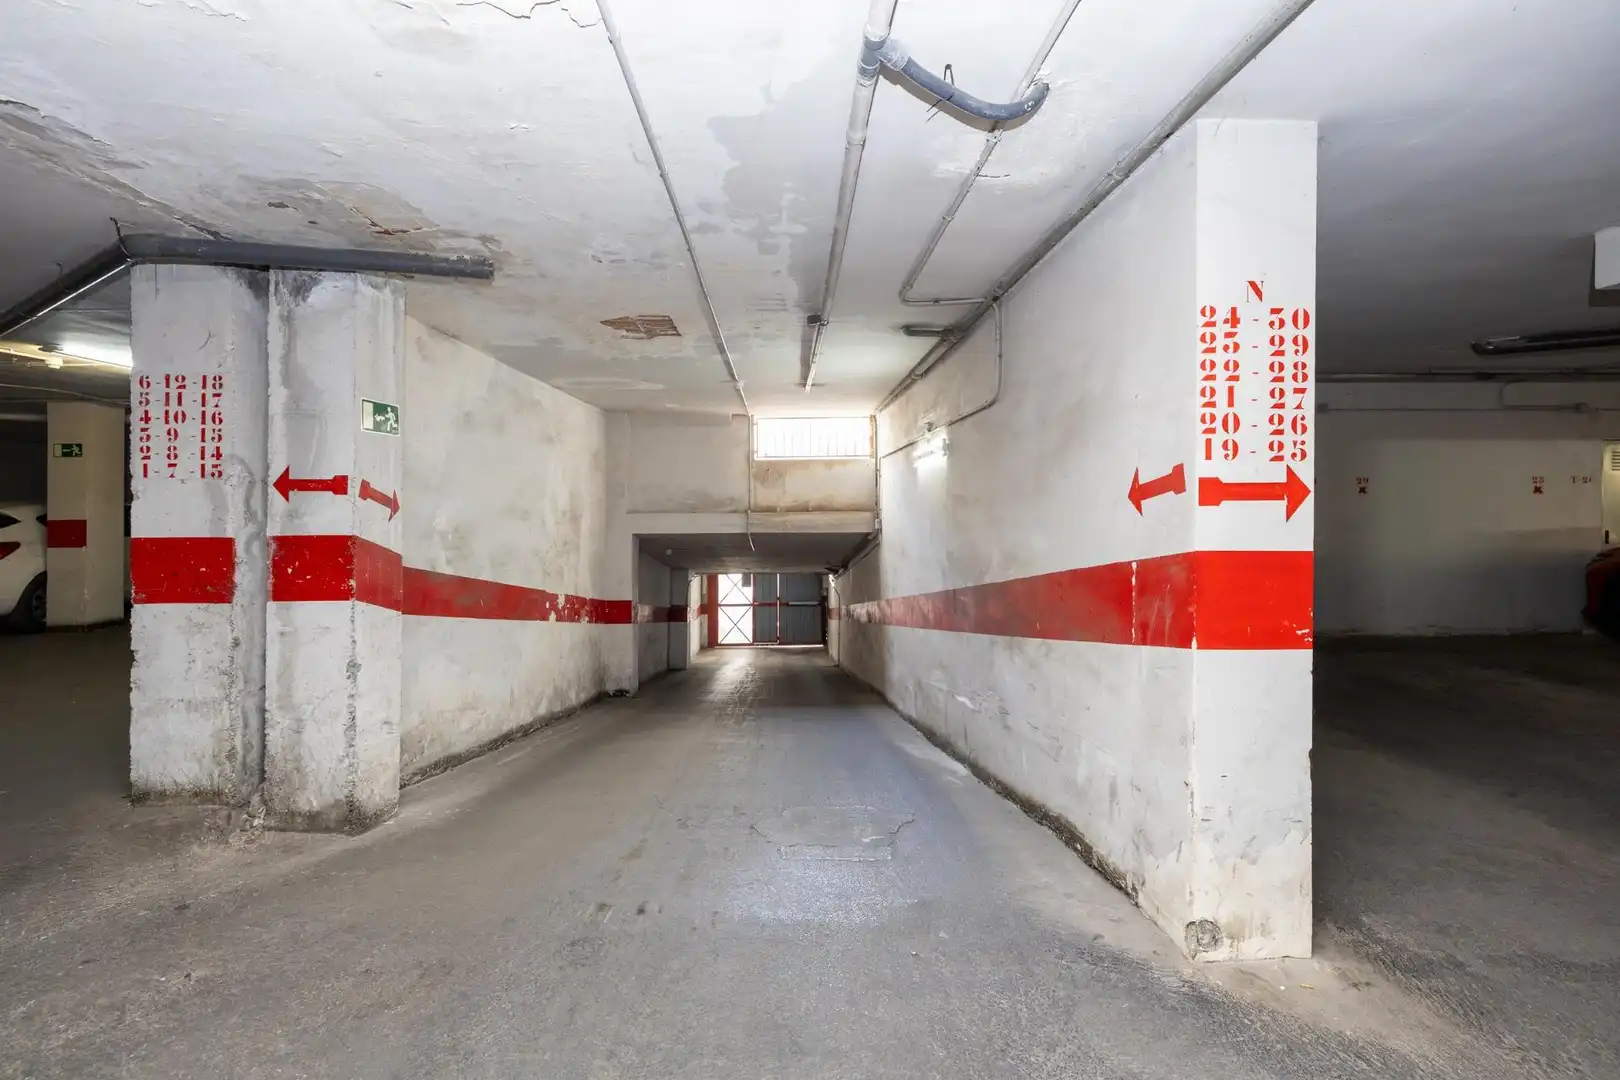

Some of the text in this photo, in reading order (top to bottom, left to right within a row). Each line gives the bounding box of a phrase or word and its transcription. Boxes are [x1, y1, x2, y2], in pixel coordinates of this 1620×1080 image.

[1246, 280, 1265, 303] N
[1200, 305, 1241, 329] 24
[1268, 308, 1310, 331] 30
[1200, 331, 1241, 354] 23
[1269, 334, 1309, 357] 29
[139, 374, 151, 389] 6
[164, 374, 186, 389] 12
[202, 374, 223, 390] 18
[1200, 358, 1241, 382] 22
[1269, 360, 1309, 383] 28
[164, 392, 182, 407] 11
[201, 392, 222, 408] 17
[1200, 385, 1236, 409] 21
[1269, 387, 1308, 410] 27
[139, 409, 151, 424] 4
[164, 409, 187, 425] 10
[201, 410, 223, 426] 16
[1200, 412, 1241, 435] 20
[1268, 413, 1308, 436] 26
[166, 427, 179, 443] 9
[139, 445, 151, 460] 2
[167, 445, 178, 460] 8
[200, 446, 223, 461] 14
[1204, 438, 1240, 461] 19
[1268, 439, 1308, 462] 25
[143, 463, 148, 478] 1
[167, 463, 178, 478] 7
